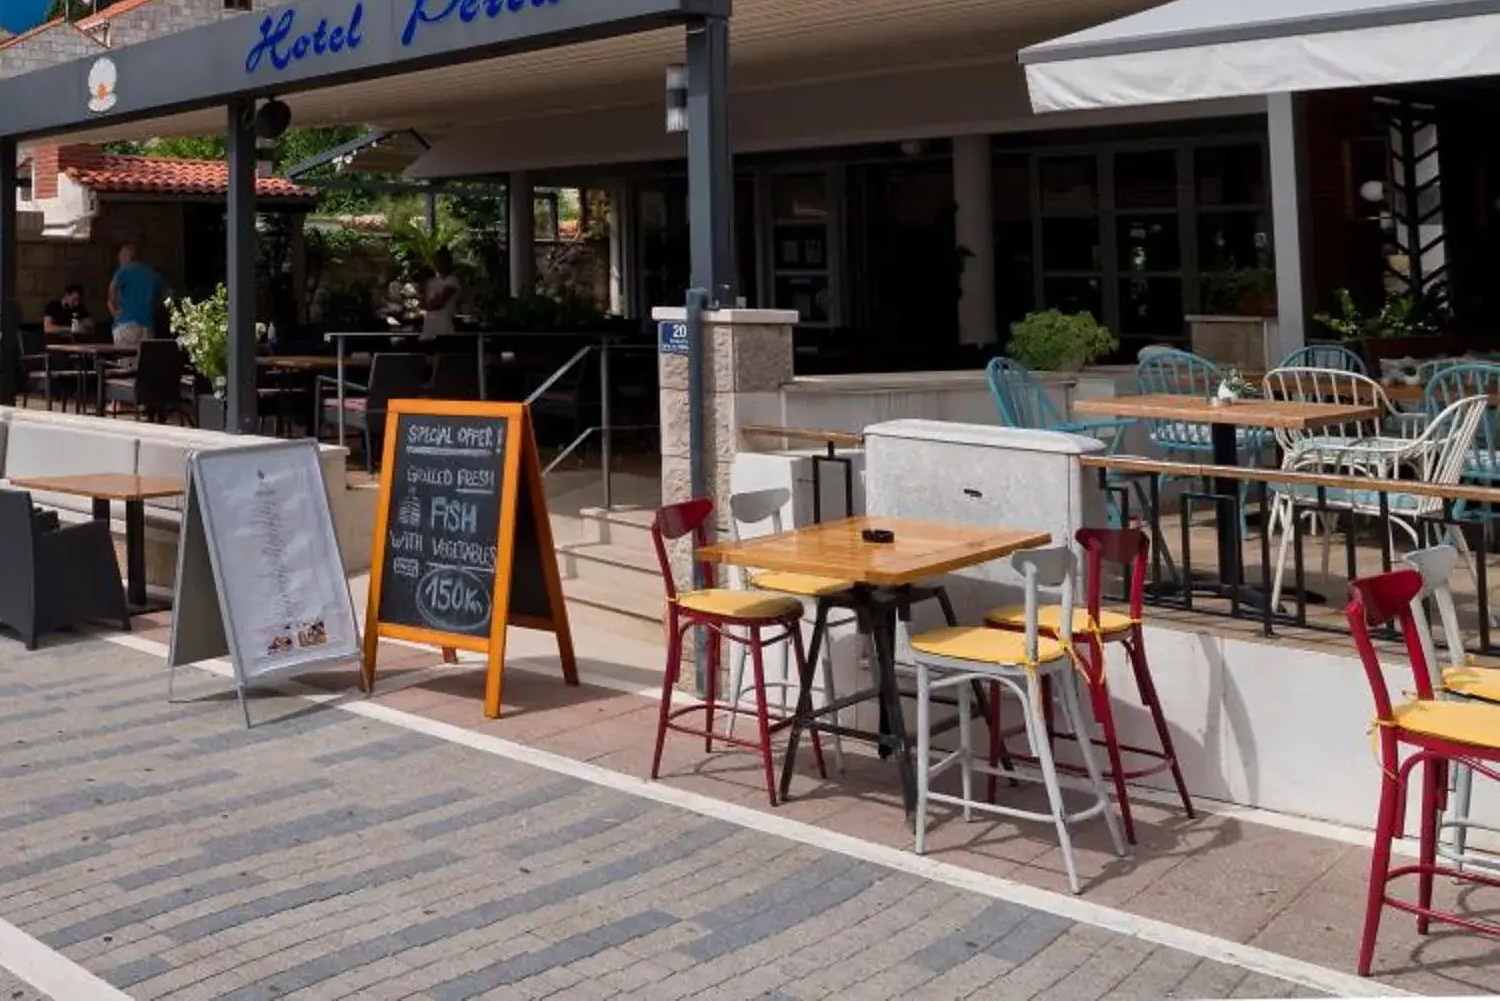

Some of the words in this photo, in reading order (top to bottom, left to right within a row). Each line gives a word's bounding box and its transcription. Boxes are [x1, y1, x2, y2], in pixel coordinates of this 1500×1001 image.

[246, 2, 364, 73] Hotel
[673, 324, 687, 338] 20
[408, 424, 452, 445] SPECIAL
[407, 465, 453, 487] GRILLED
[457, 469, 495, 487] FRESH
[431, 497, 477, 533] FISH
[389, 530, 422, 552] WITH
[432, 537, 497, 566] VEGETABLES
